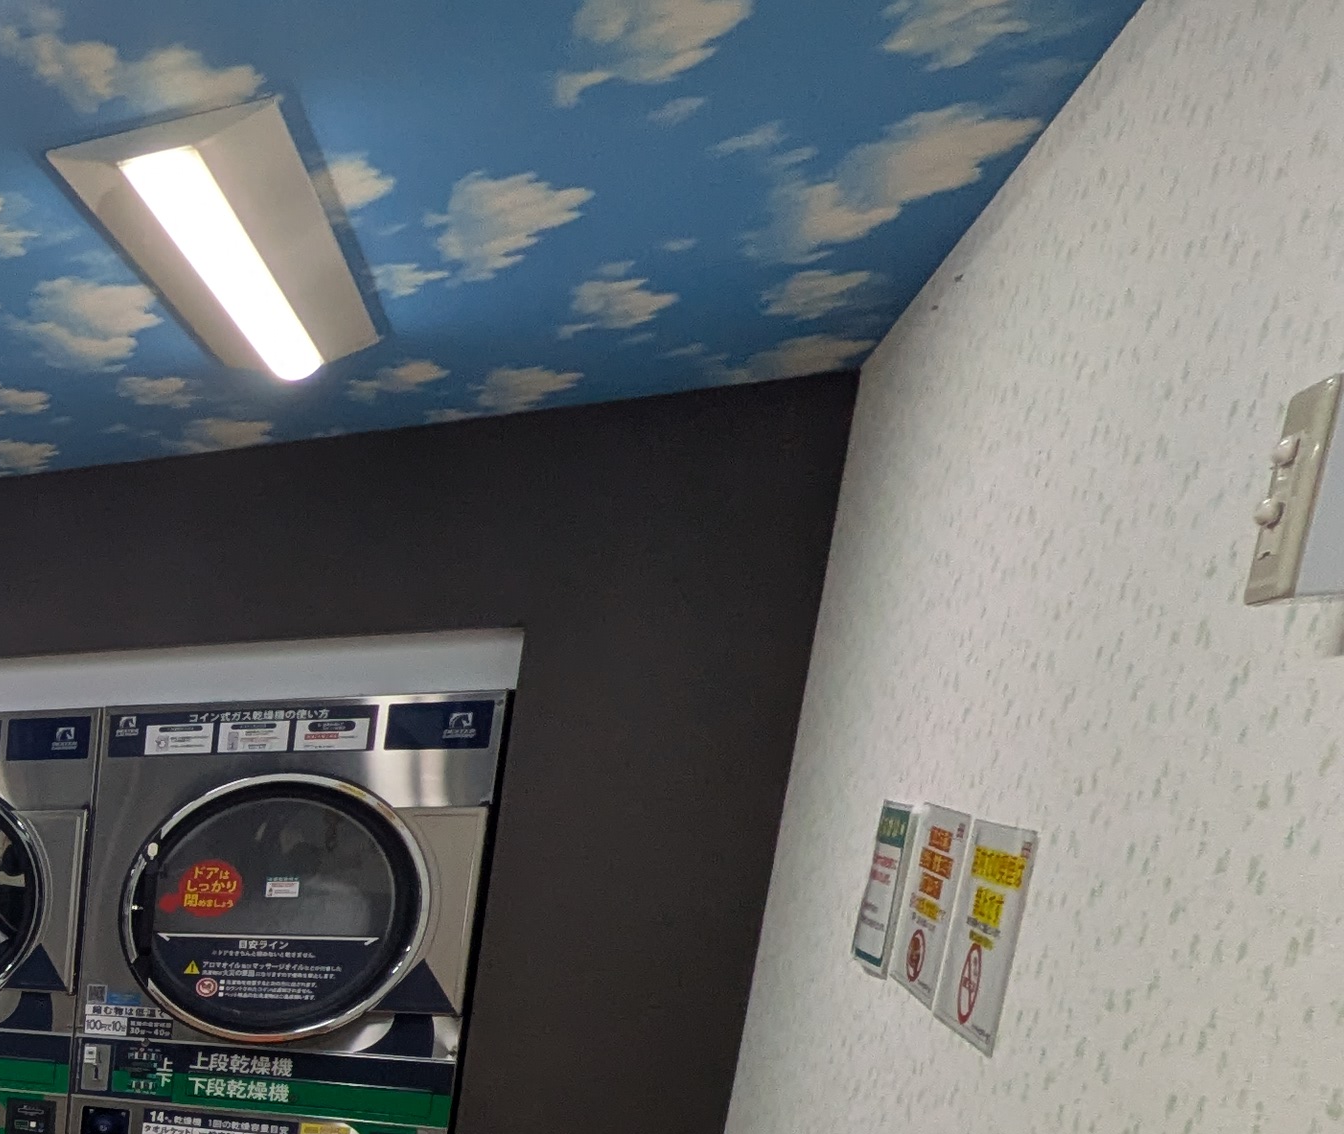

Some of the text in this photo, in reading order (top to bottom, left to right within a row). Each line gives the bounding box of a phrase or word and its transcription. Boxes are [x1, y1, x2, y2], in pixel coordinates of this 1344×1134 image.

[189, 709, 330, 723] コイン式ガス乾燥機の使い方
[194, 867, 230, 880] ドアは
[187, 880, 237, 893] しっかり
[184, 894, 234, 908] 閉めましょう
[239, 940, 289, 950] 目安ライン
[157, 1057, 173, 1072] 上
[189, 1051, 293, 1078] 上段乾燥機
[156, 1072, 173, 1087] 下
[188, 1076, 289, 1103] 下段乾燥機
